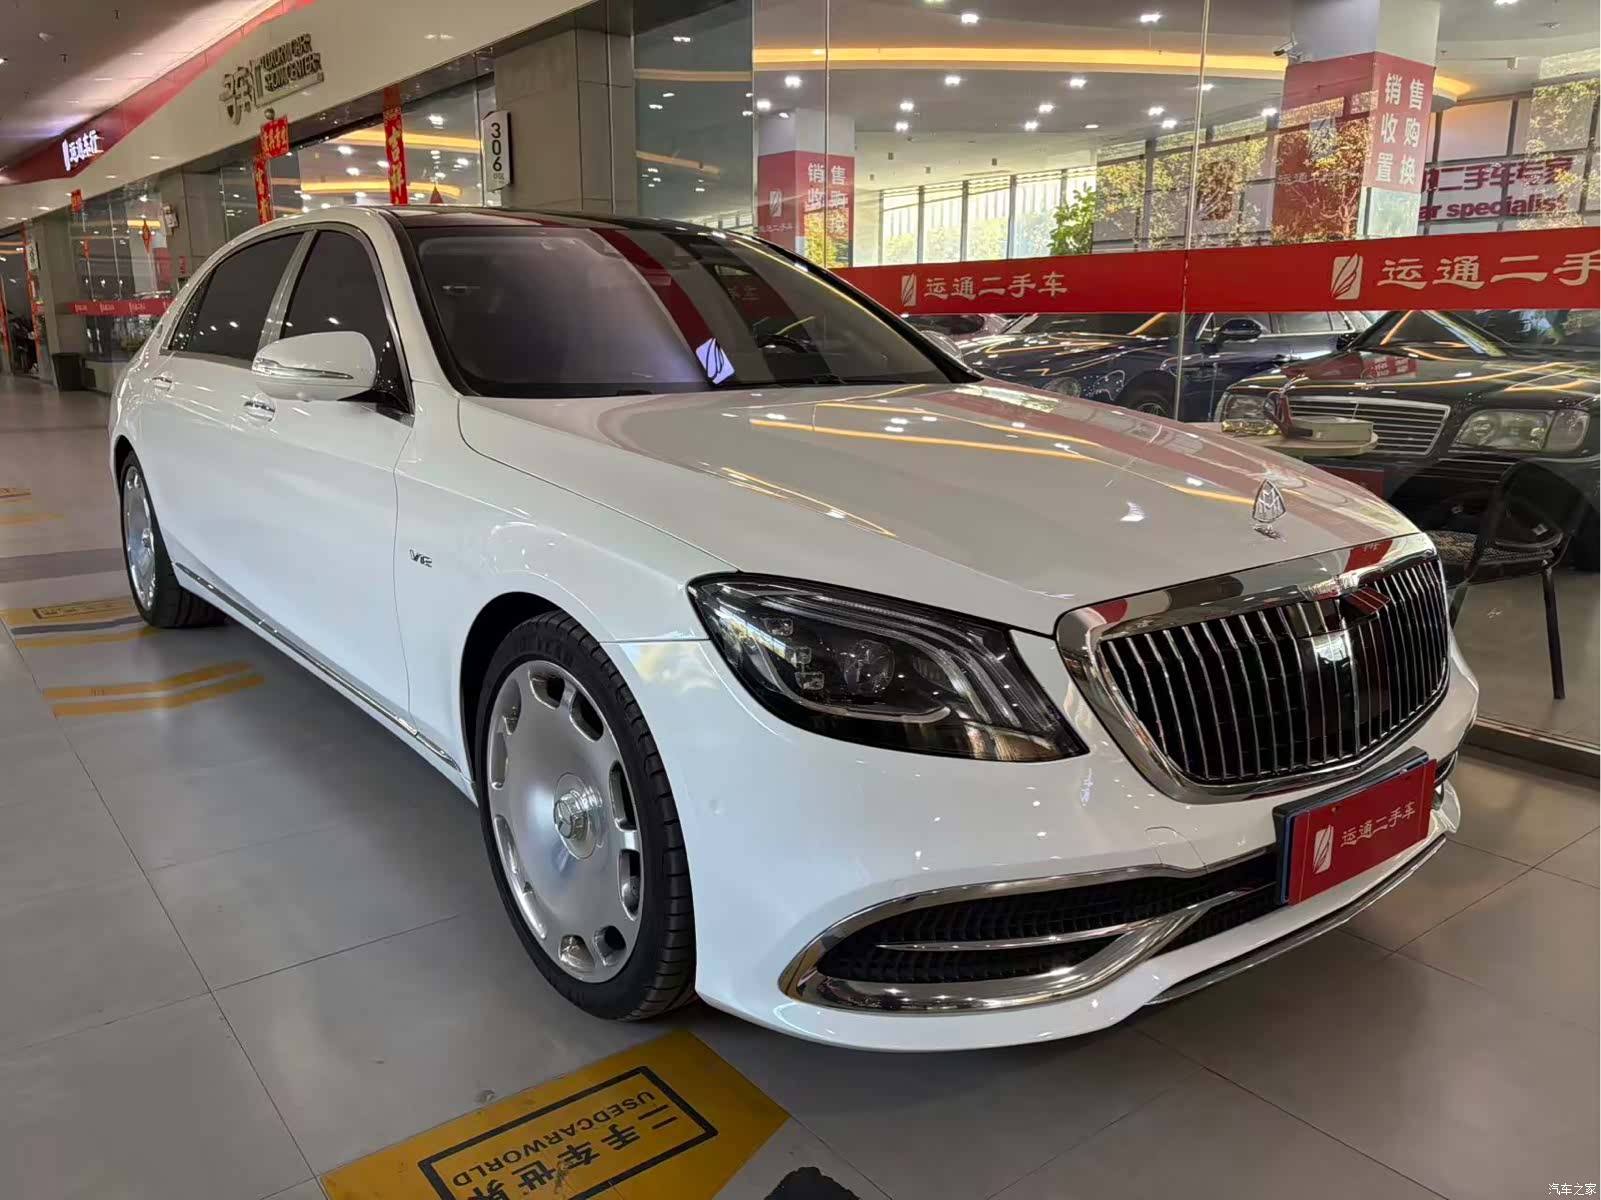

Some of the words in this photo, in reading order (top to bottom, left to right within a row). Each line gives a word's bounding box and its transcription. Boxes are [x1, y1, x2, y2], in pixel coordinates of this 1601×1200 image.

[1385, 72, 1425, 110] 销售
[491, 122, 503, 172] 306
[1381, 112, 1421, 148] 收购
[808, 162, 846, 186] 销售
[1376, 152, 1416, 184] 置换
[924, 271, 1068, 298] 运通二手车
[1377, 249, 1600, 290] 运通二手
[1340, 801, 1416, 847] 运通二手车
[452, 1091, 656, 1187] USEDCARWORLD
